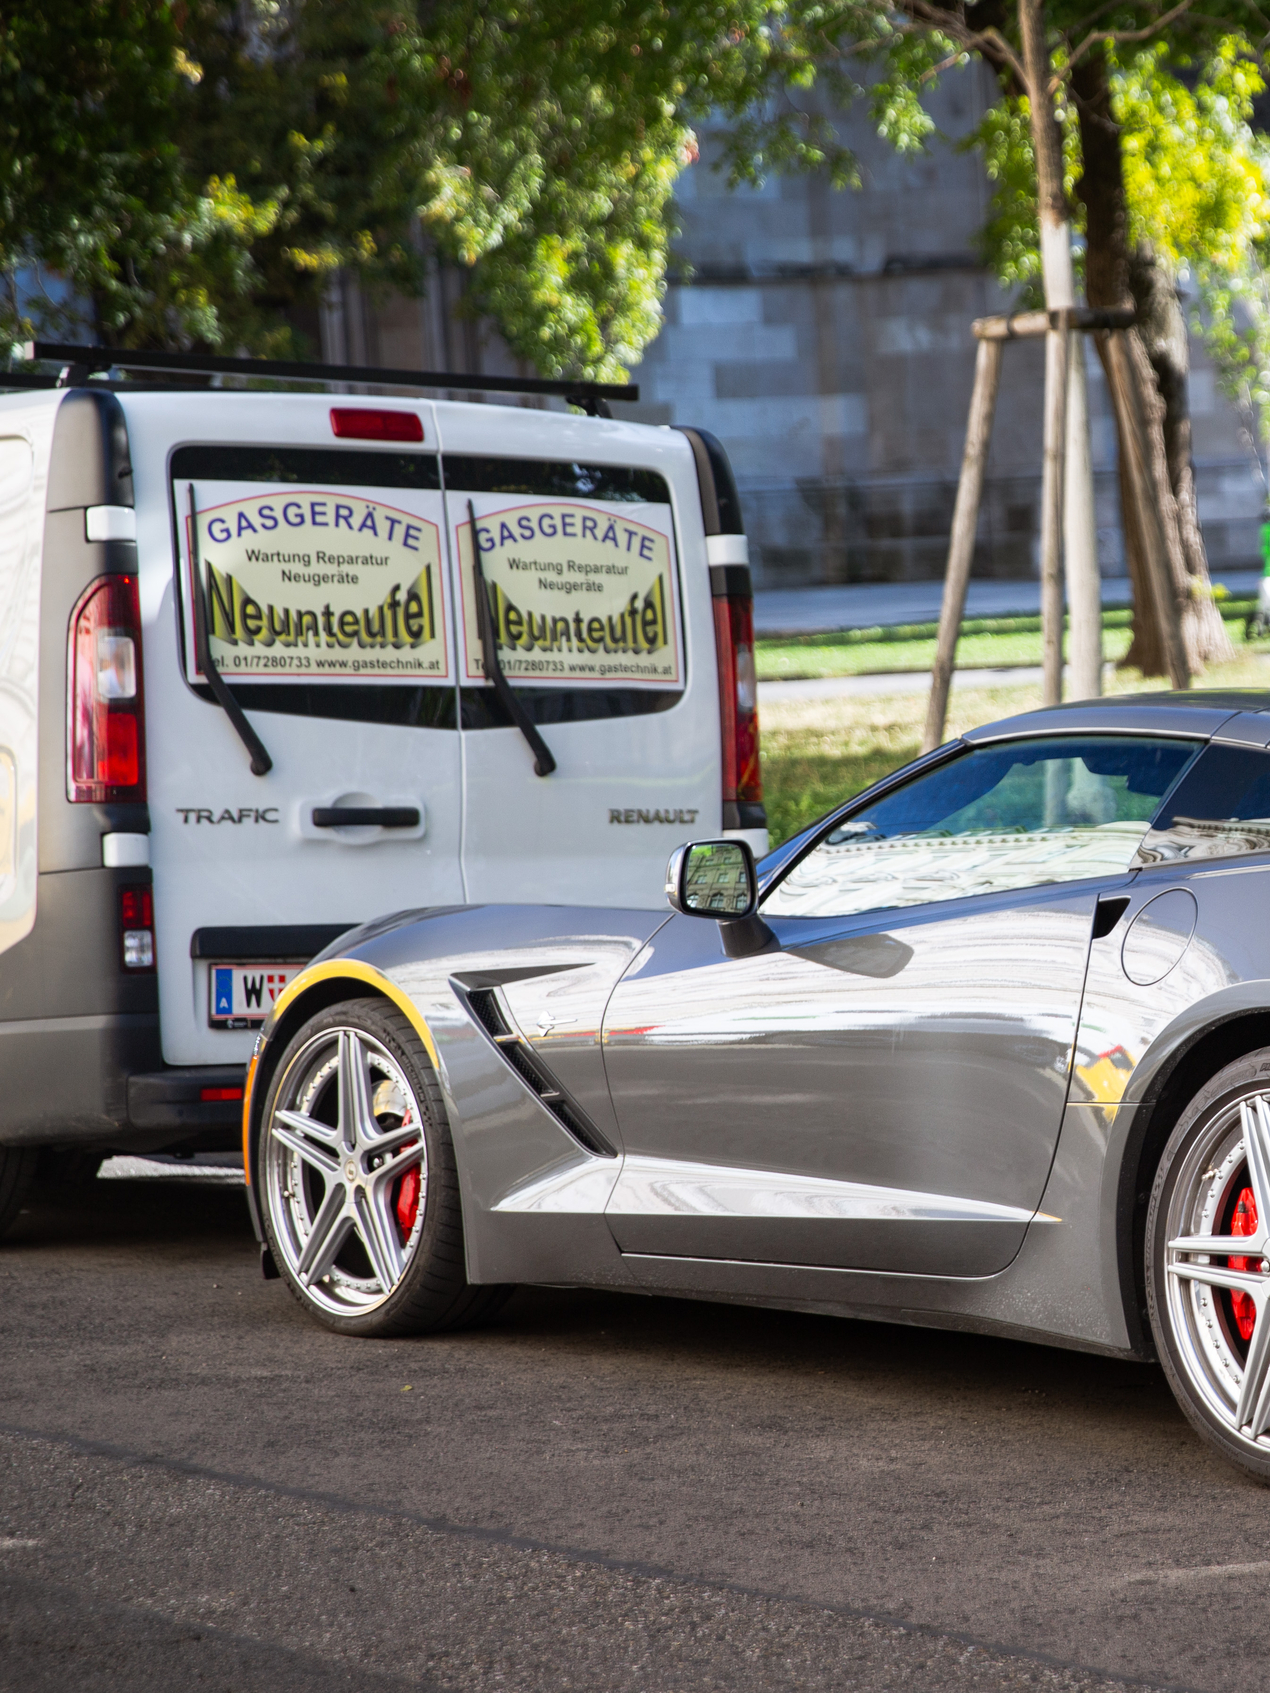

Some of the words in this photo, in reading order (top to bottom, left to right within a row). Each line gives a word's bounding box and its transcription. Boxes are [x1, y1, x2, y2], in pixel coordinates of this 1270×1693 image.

[207, 501, 422, 551] GASGERÄTE
[477, 513, 655, 561] GASGERÄTE
[245, 549, 311, 566] Wartung
[316, 551, 390, 567] Reparatur
[507, 557, 564, 575] Wartung
[567, 559, 629, 575] Reparatur
[281, 569, 359, 586] Neugeräte
[538, 577, 604, 593] Neugeräte
[205, 559, 436, 648] Neunteufel
[211, 655, 229, 668] el.
[233, 655, 311, 668] 01/7280733
[315, 658, 440, 672] www.gastechnik.at
[568, 662, 673, 676] www.gastechnik.at
[175, 807, 280, 824] TRAFIC
[608, 808, 699, 824] RENAULT
[243, 974, 264, 1008] W
[219, 997, 229, 1009] A
